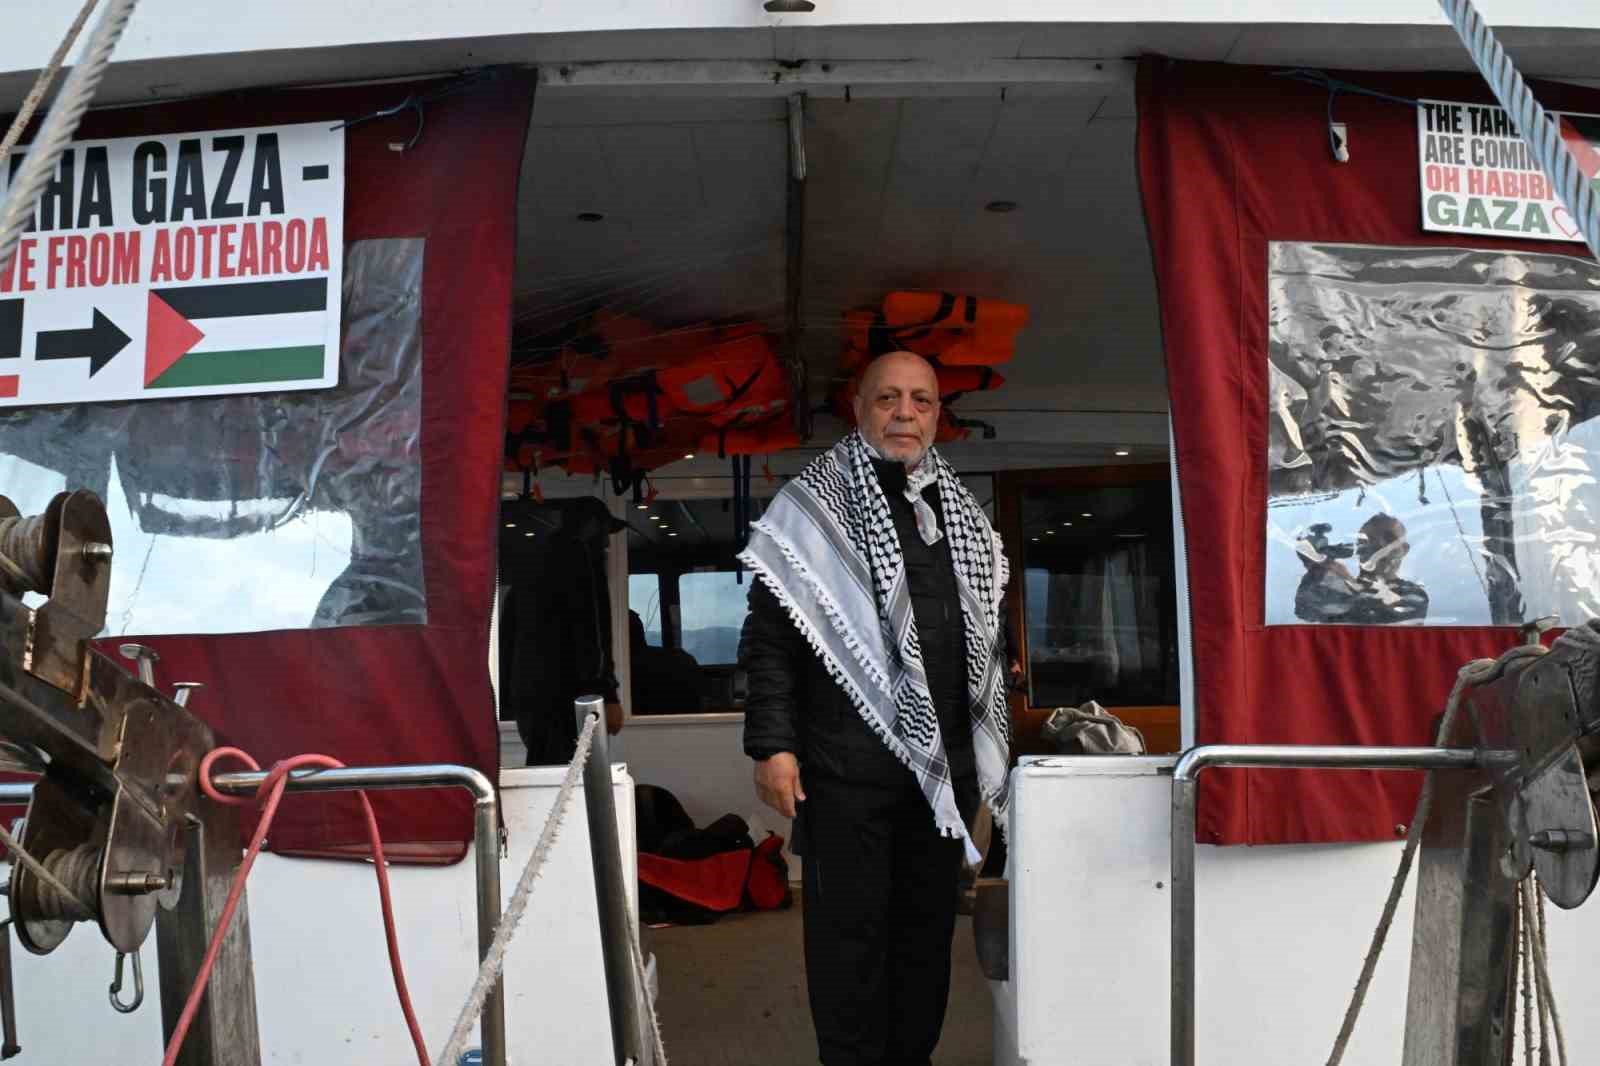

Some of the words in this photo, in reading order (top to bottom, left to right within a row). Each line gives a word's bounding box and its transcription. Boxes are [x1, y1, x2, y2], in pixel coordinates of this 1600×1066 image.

[1423, 104, 1463, 134] THE
[1425, 134, 1466, 165] ARE
[132, 133, 285, 226] GAZA
[1425, 165, 1460, 192] OH
[1427, 194, 1550, 234] GAZA
[47, 231, 141, 290] FROM
[150, 217, 329, 283] AOTEAROA
